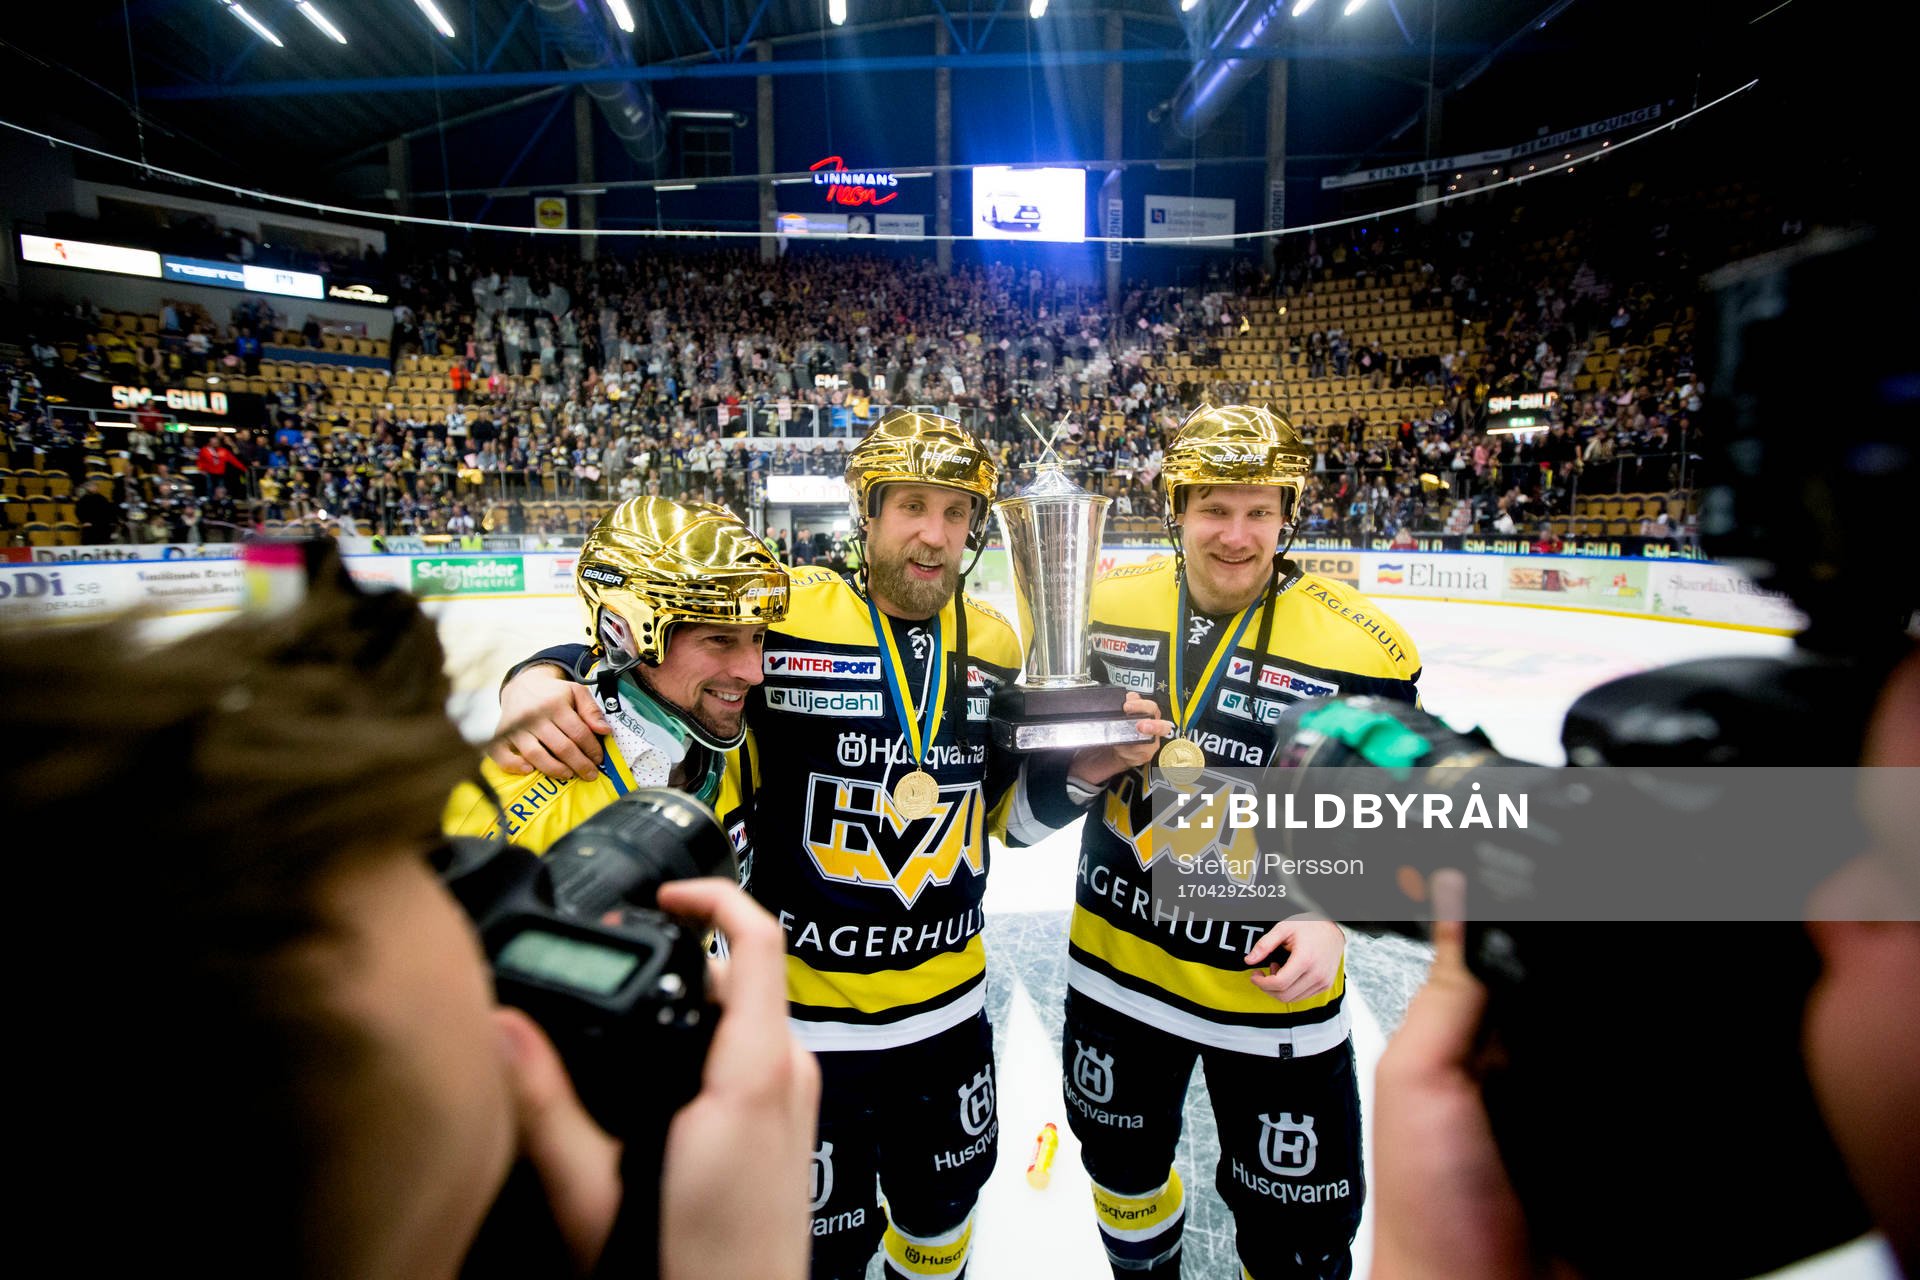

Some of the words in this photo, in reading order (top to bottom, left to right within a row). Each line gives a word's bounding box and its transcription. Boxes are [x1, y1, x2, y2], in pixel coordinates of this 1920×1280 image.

[1368, 159, 1455, 179] KINNARPS
[1511, 128, 1583, 157] PREMIUM
[1587, 104, 1661, 136] LOUNGE
[814, 173, 898, 186] LINNMANS
[416, 560, 518, 579] Schneider
[583, 568, 624, 586] BAUER
[1409, 563, 1488, 591] Elmia
[462, 577, 517, 590] Electric
[1305, 583, 1407, 664] FAGERHULT
[1101, 636, 1156, 658] INTERSPORT
[787, 656, 877, 675] INTERSPORT
[788, 691, 880, 712] Liljedahl
[1232, 1158, 1350, 1204] Husqvarna
